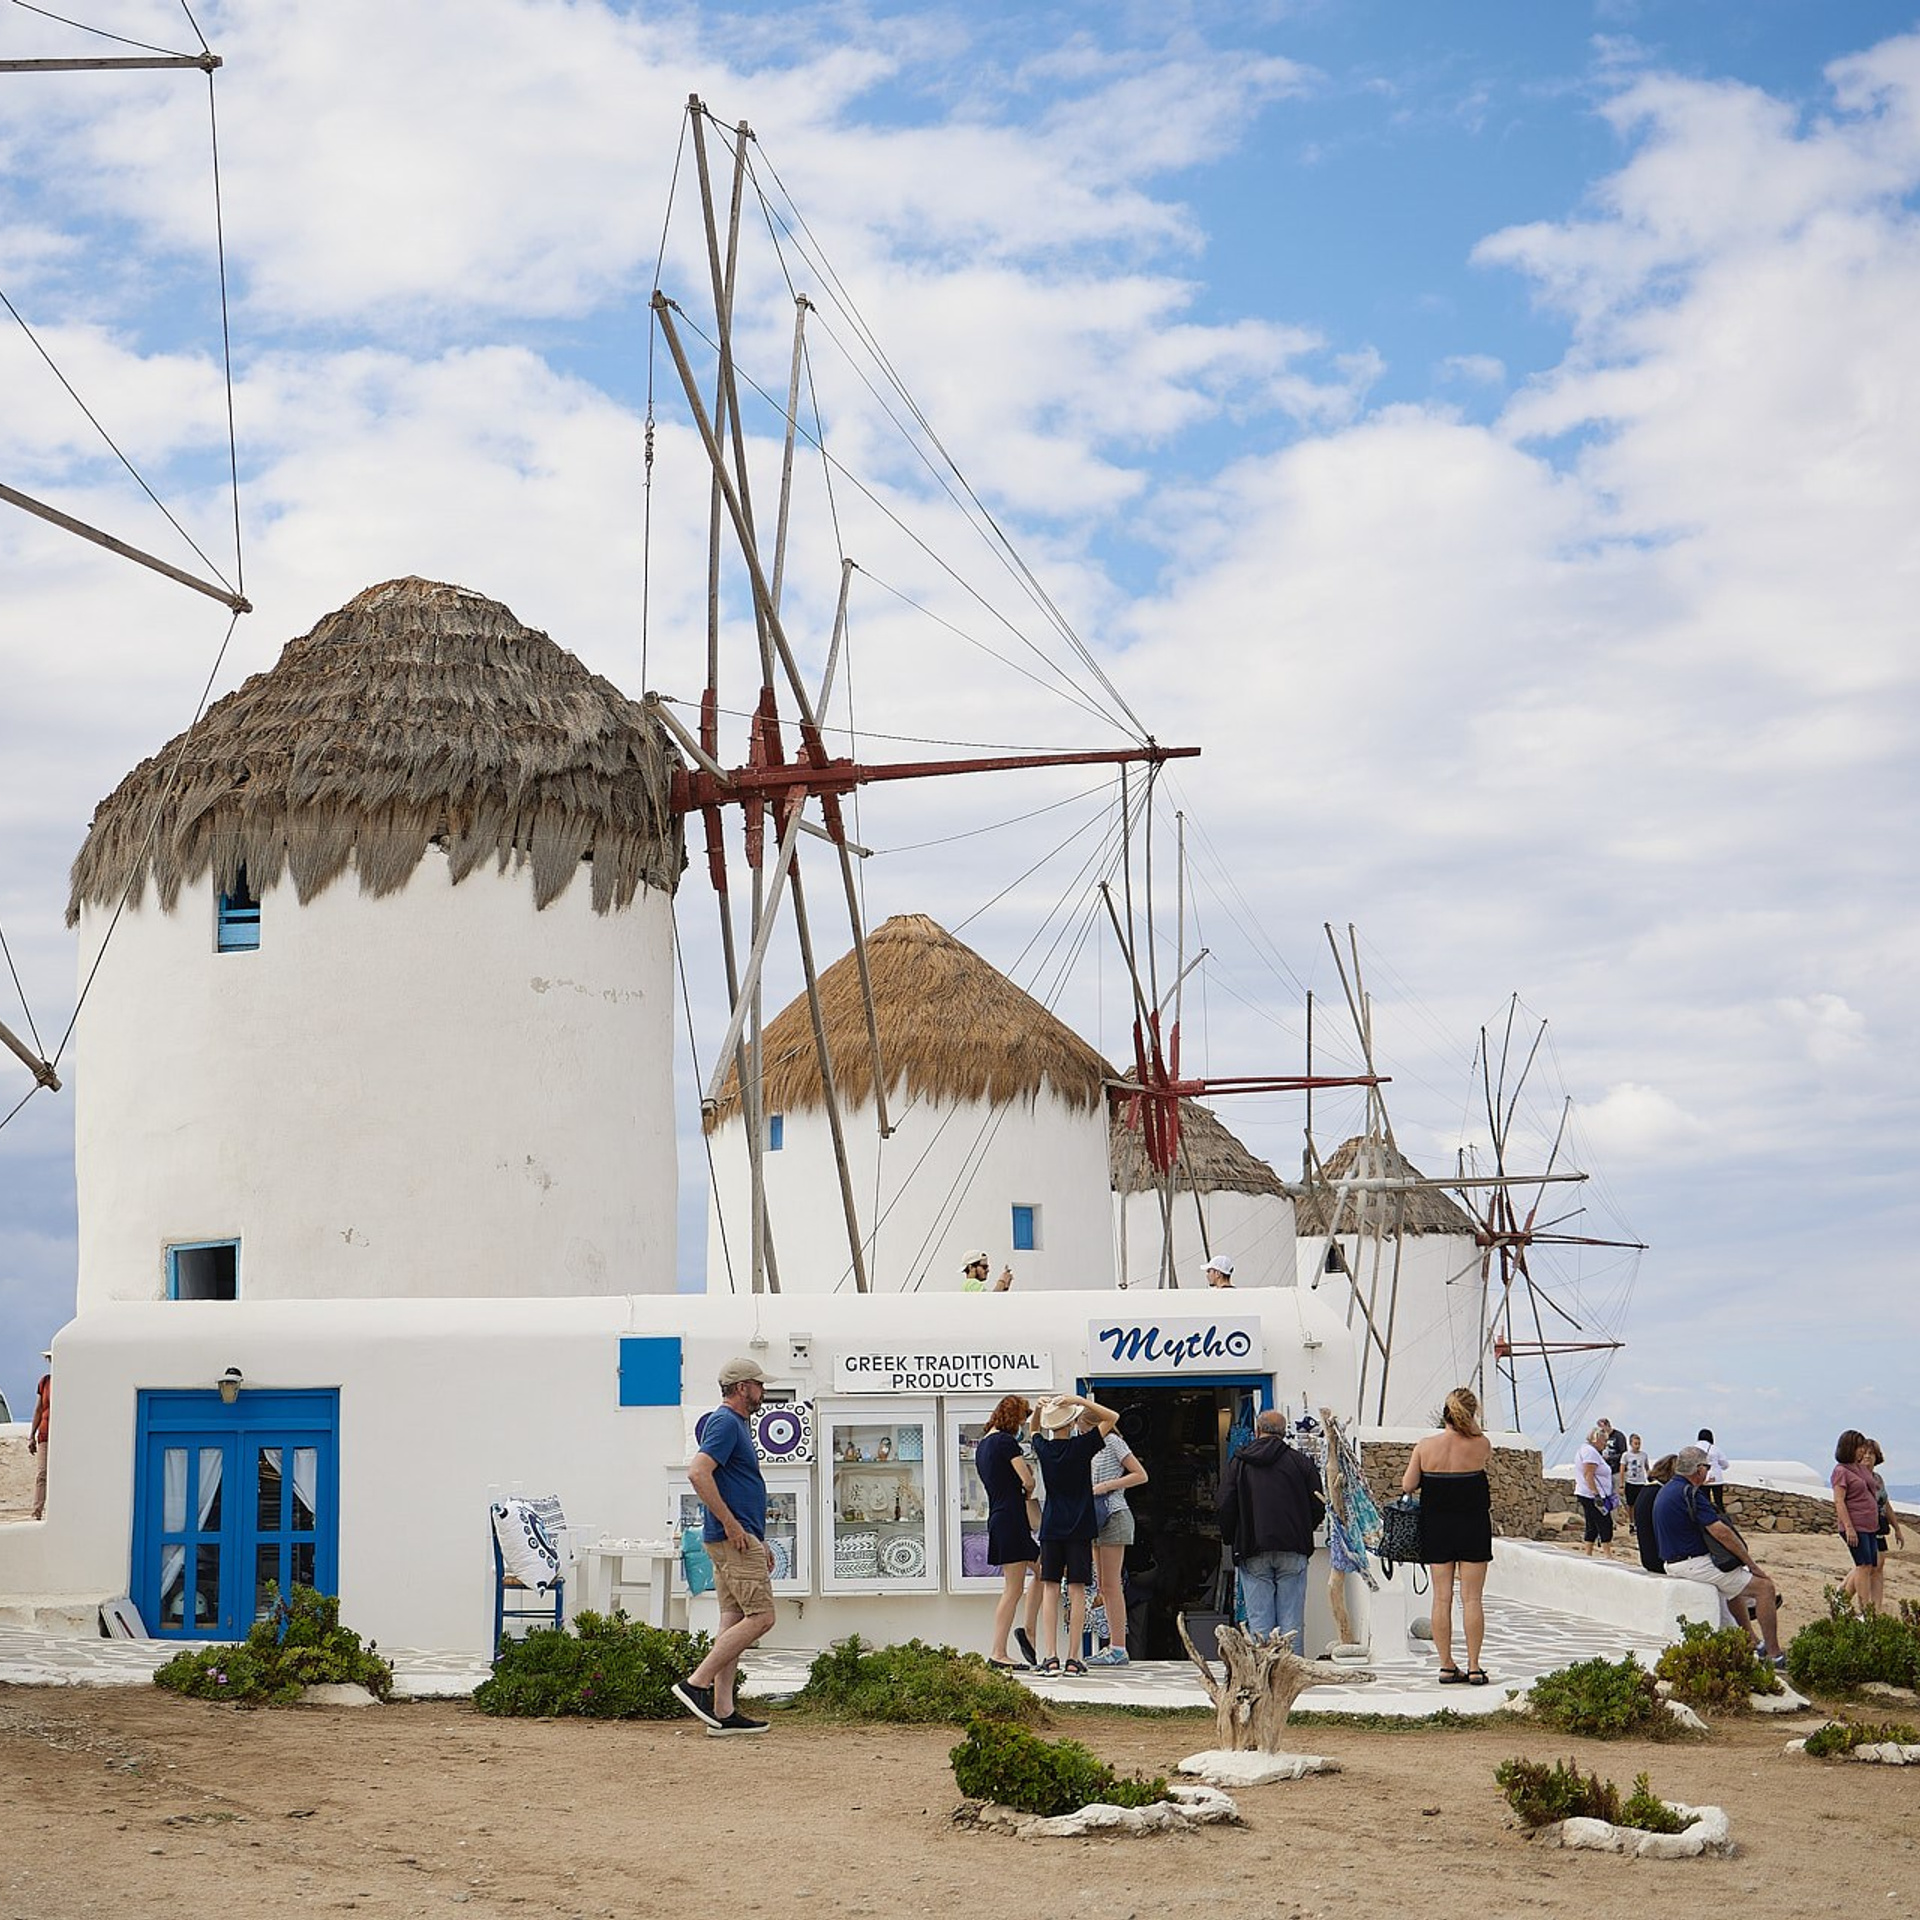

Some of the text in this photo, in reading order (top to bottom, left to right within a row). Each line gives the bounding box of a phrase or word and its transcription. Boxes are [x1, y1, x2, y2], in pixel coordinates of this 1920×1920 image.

[845, 1355, 1040, 1371] GREEK TRADITIONAL
[892, 1373, 994, 1388] PRODUCTS
